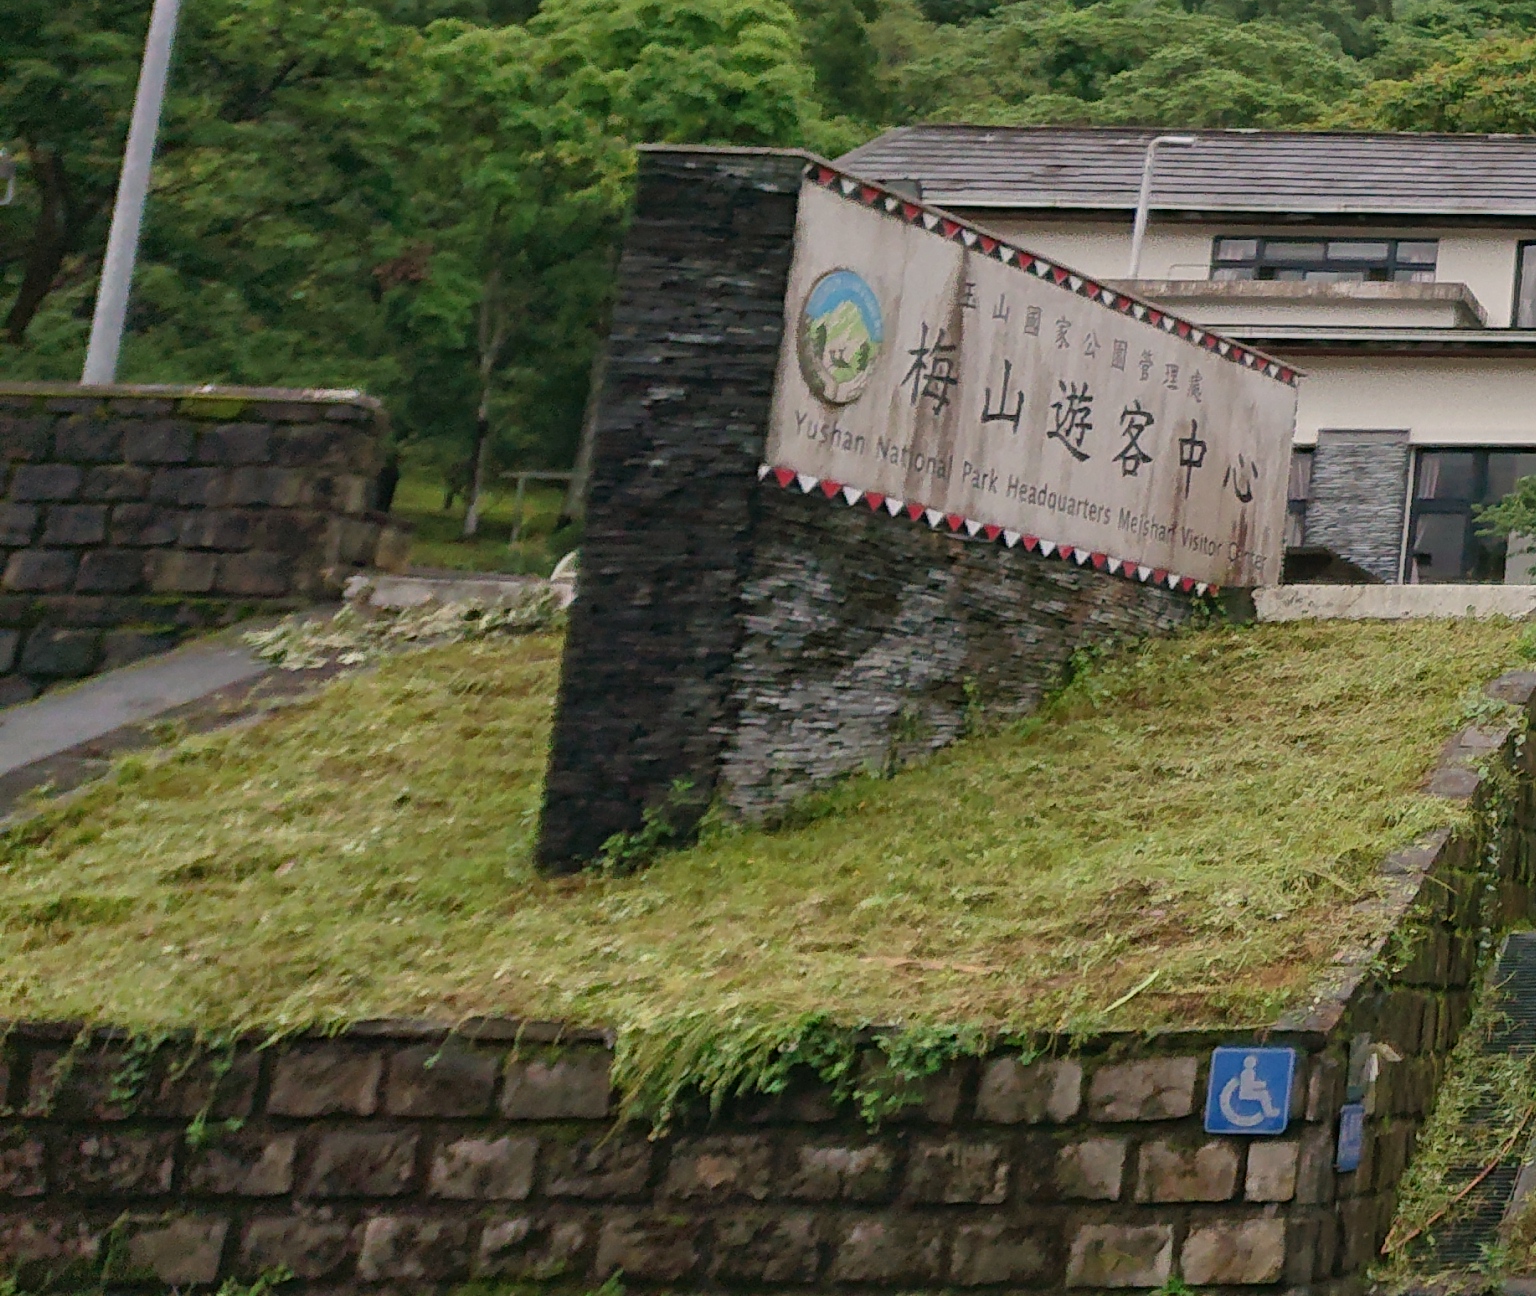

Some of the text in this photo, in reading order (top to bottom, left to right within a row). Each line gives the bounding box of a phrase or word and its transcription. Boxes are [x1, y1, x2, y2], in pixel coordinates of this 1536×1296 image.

[795, 410, 866, 455] Yushan
[875, 436, 954, 481] National
[962, 460, 998, 494] Park
[1006, 474, 1112, 526] Headquarters
[1117, 506, 1178, 544] Meishan
[1181, 527, 1223, 558] Visitor
[899, 321, 1259, 503] 梅山遊客中心
